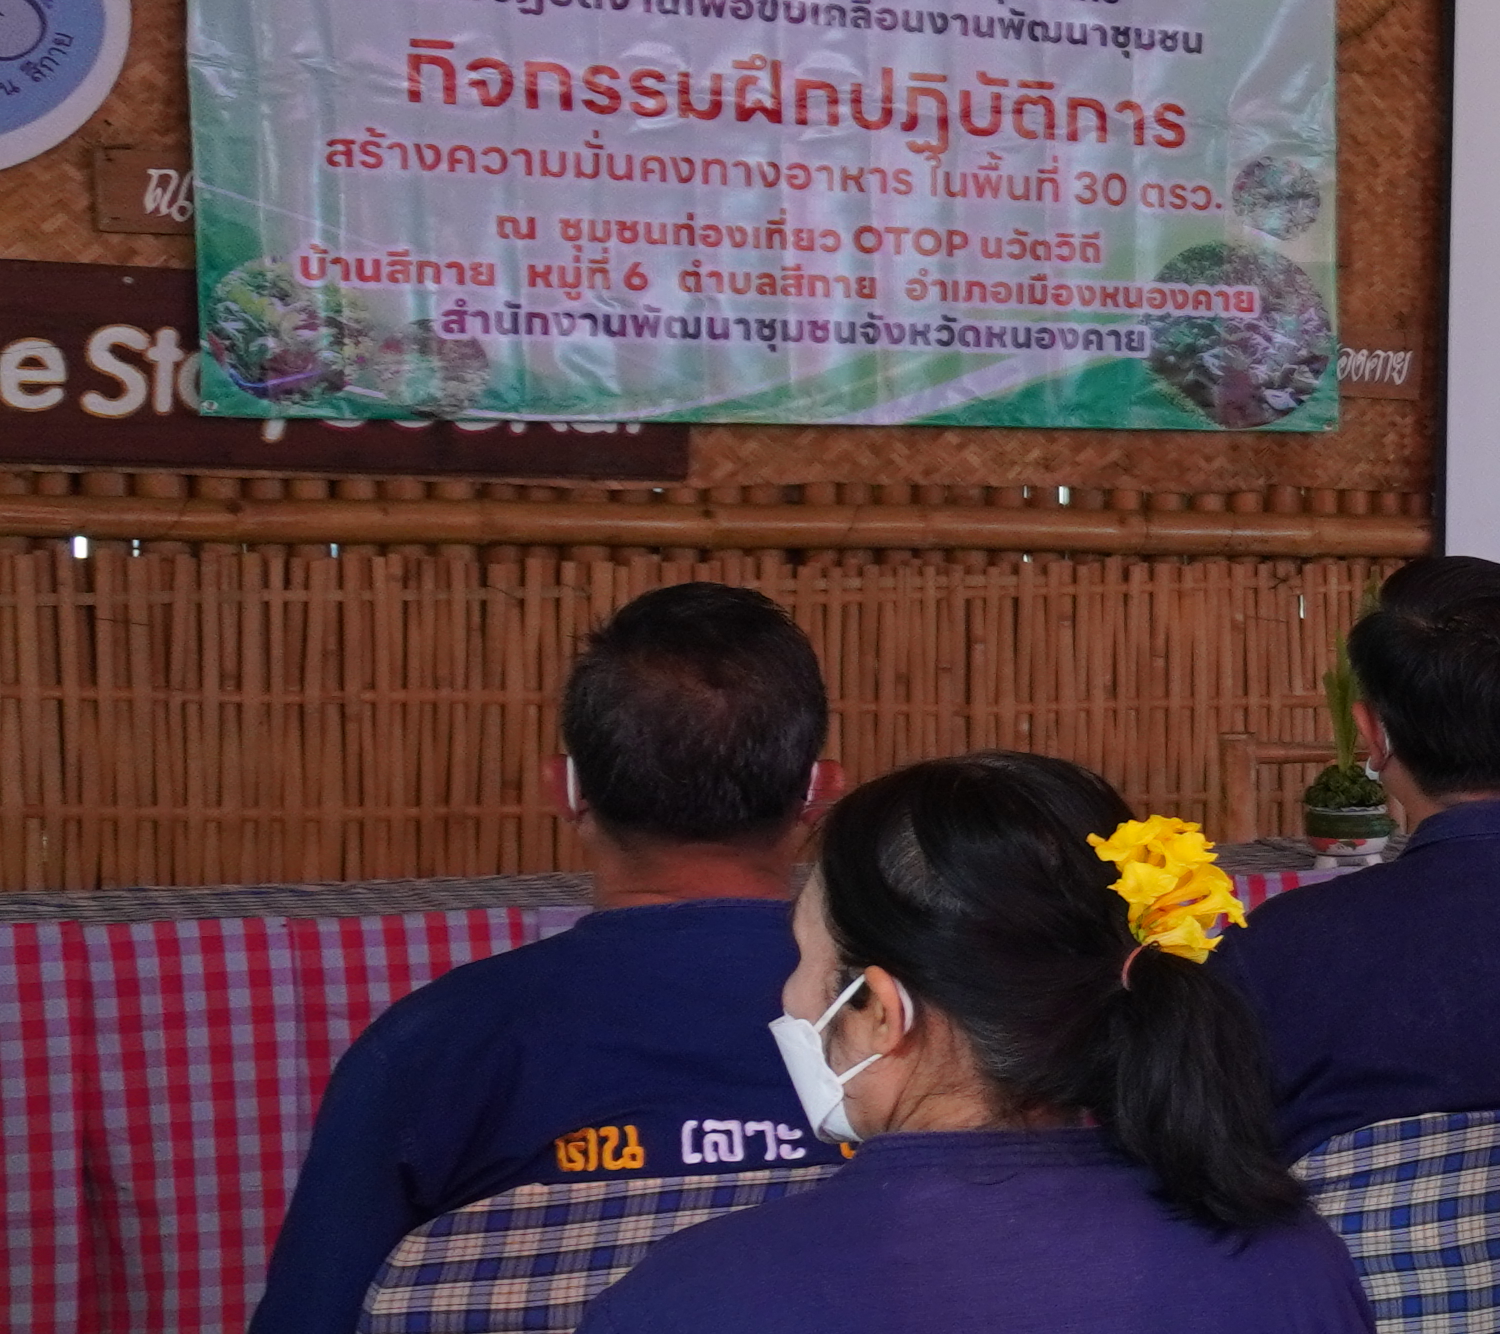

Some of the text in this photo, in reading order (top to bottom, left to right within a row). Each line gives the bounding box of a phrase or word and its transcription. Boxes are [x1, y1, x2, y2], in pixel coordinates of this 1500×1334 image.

[406, 38, 1187, 154] กิจกรรมฝึกปฏิบัติการ
[325, 127, 1224, 211] สร้างความมั่นคงทางอาหาร ในพื้นที่ 30 ตรว.
[496, 208, 1102, 265] ณ ชุมชนท่องเที่ยว OTOP นวัตวิถี
[299, 243, 1256, 314] บ้านสีกาย หมู่ที่ 6 ตำบลสีกาย อำเภอเมืองหนองคาย
[440, 298, 1146, 353] สำนักงานพัฒนาชุมชนจังหวัดหนองคาย
[680, 1118, 807, 1165] เลาะ
